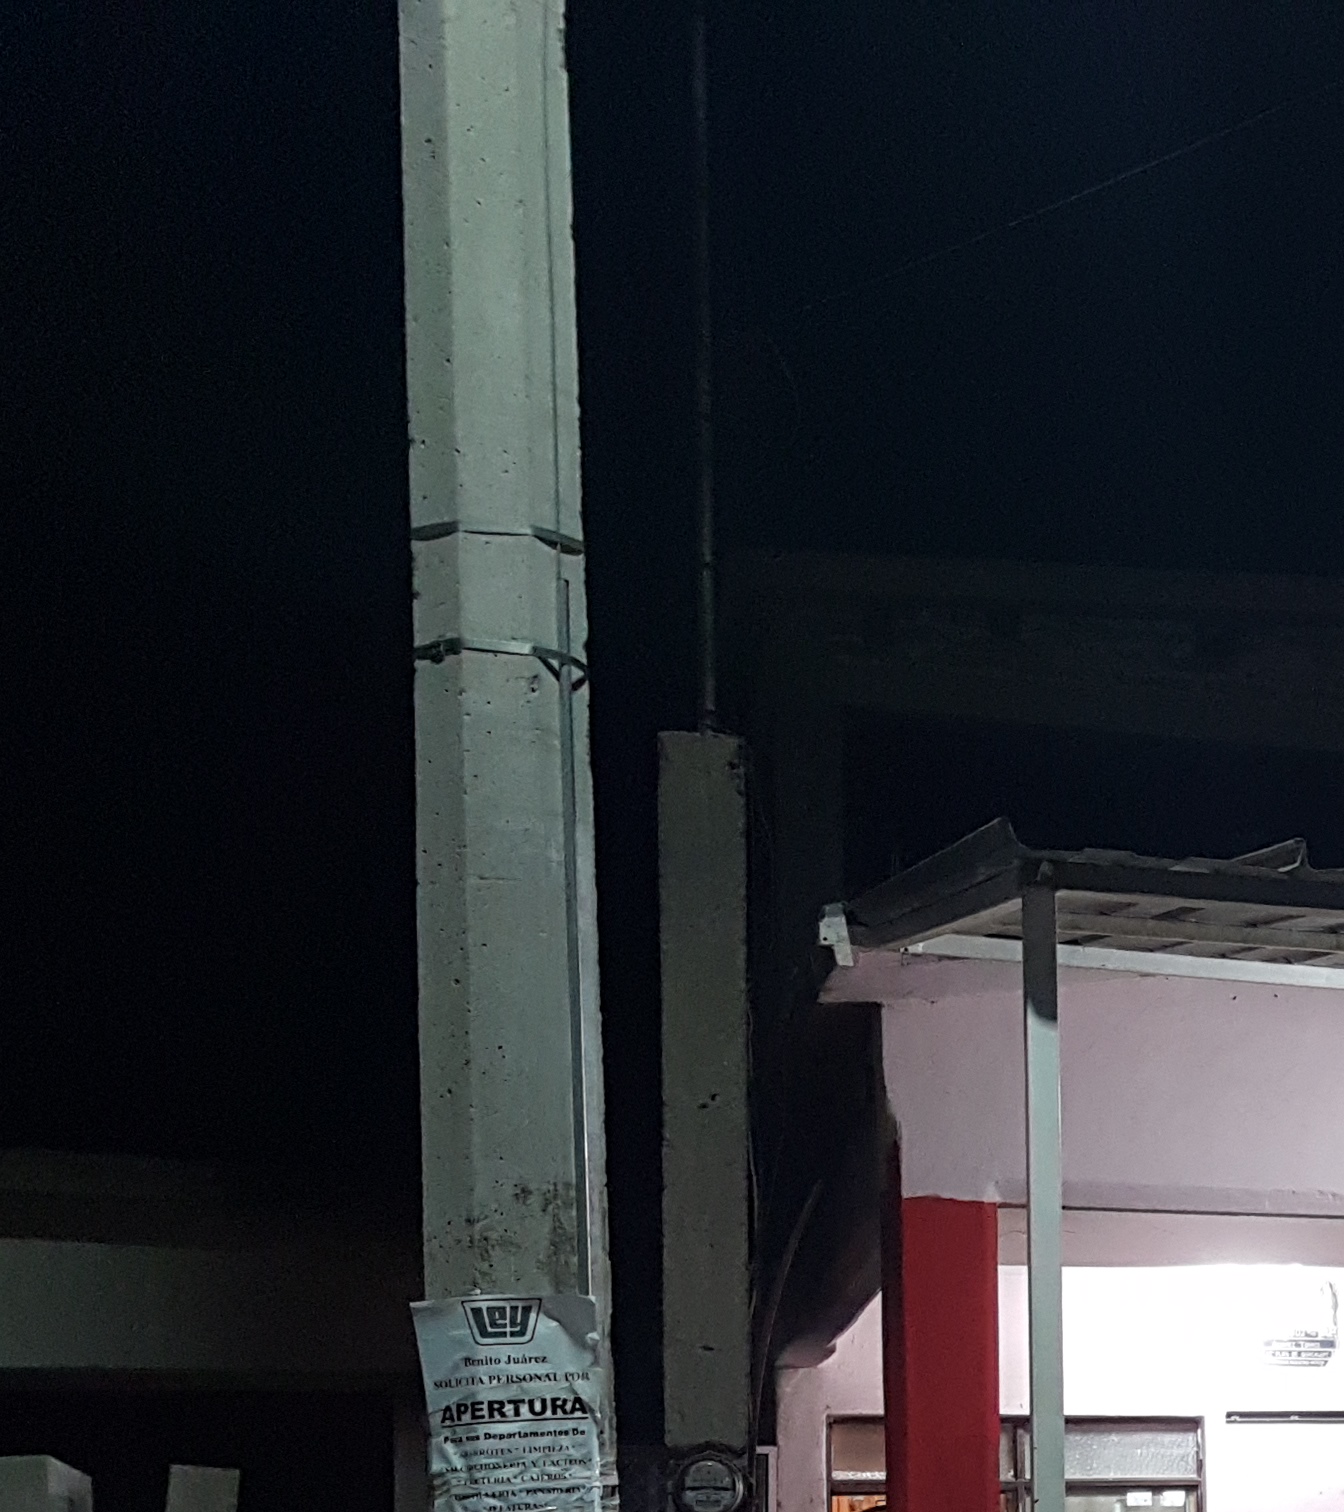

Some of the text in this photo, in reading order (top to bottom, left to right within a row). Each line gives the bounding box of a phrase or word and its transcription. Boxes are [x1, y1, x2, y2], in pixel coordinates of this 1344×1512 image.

[464, 1353, 549, 1367] Benito Juárez
[433, 1371, 591, 1390] SOLICITA PERSONAL POR
[440, 1396, 588, 1424] APERTURA
[572, 1428, 586, 1436] De
